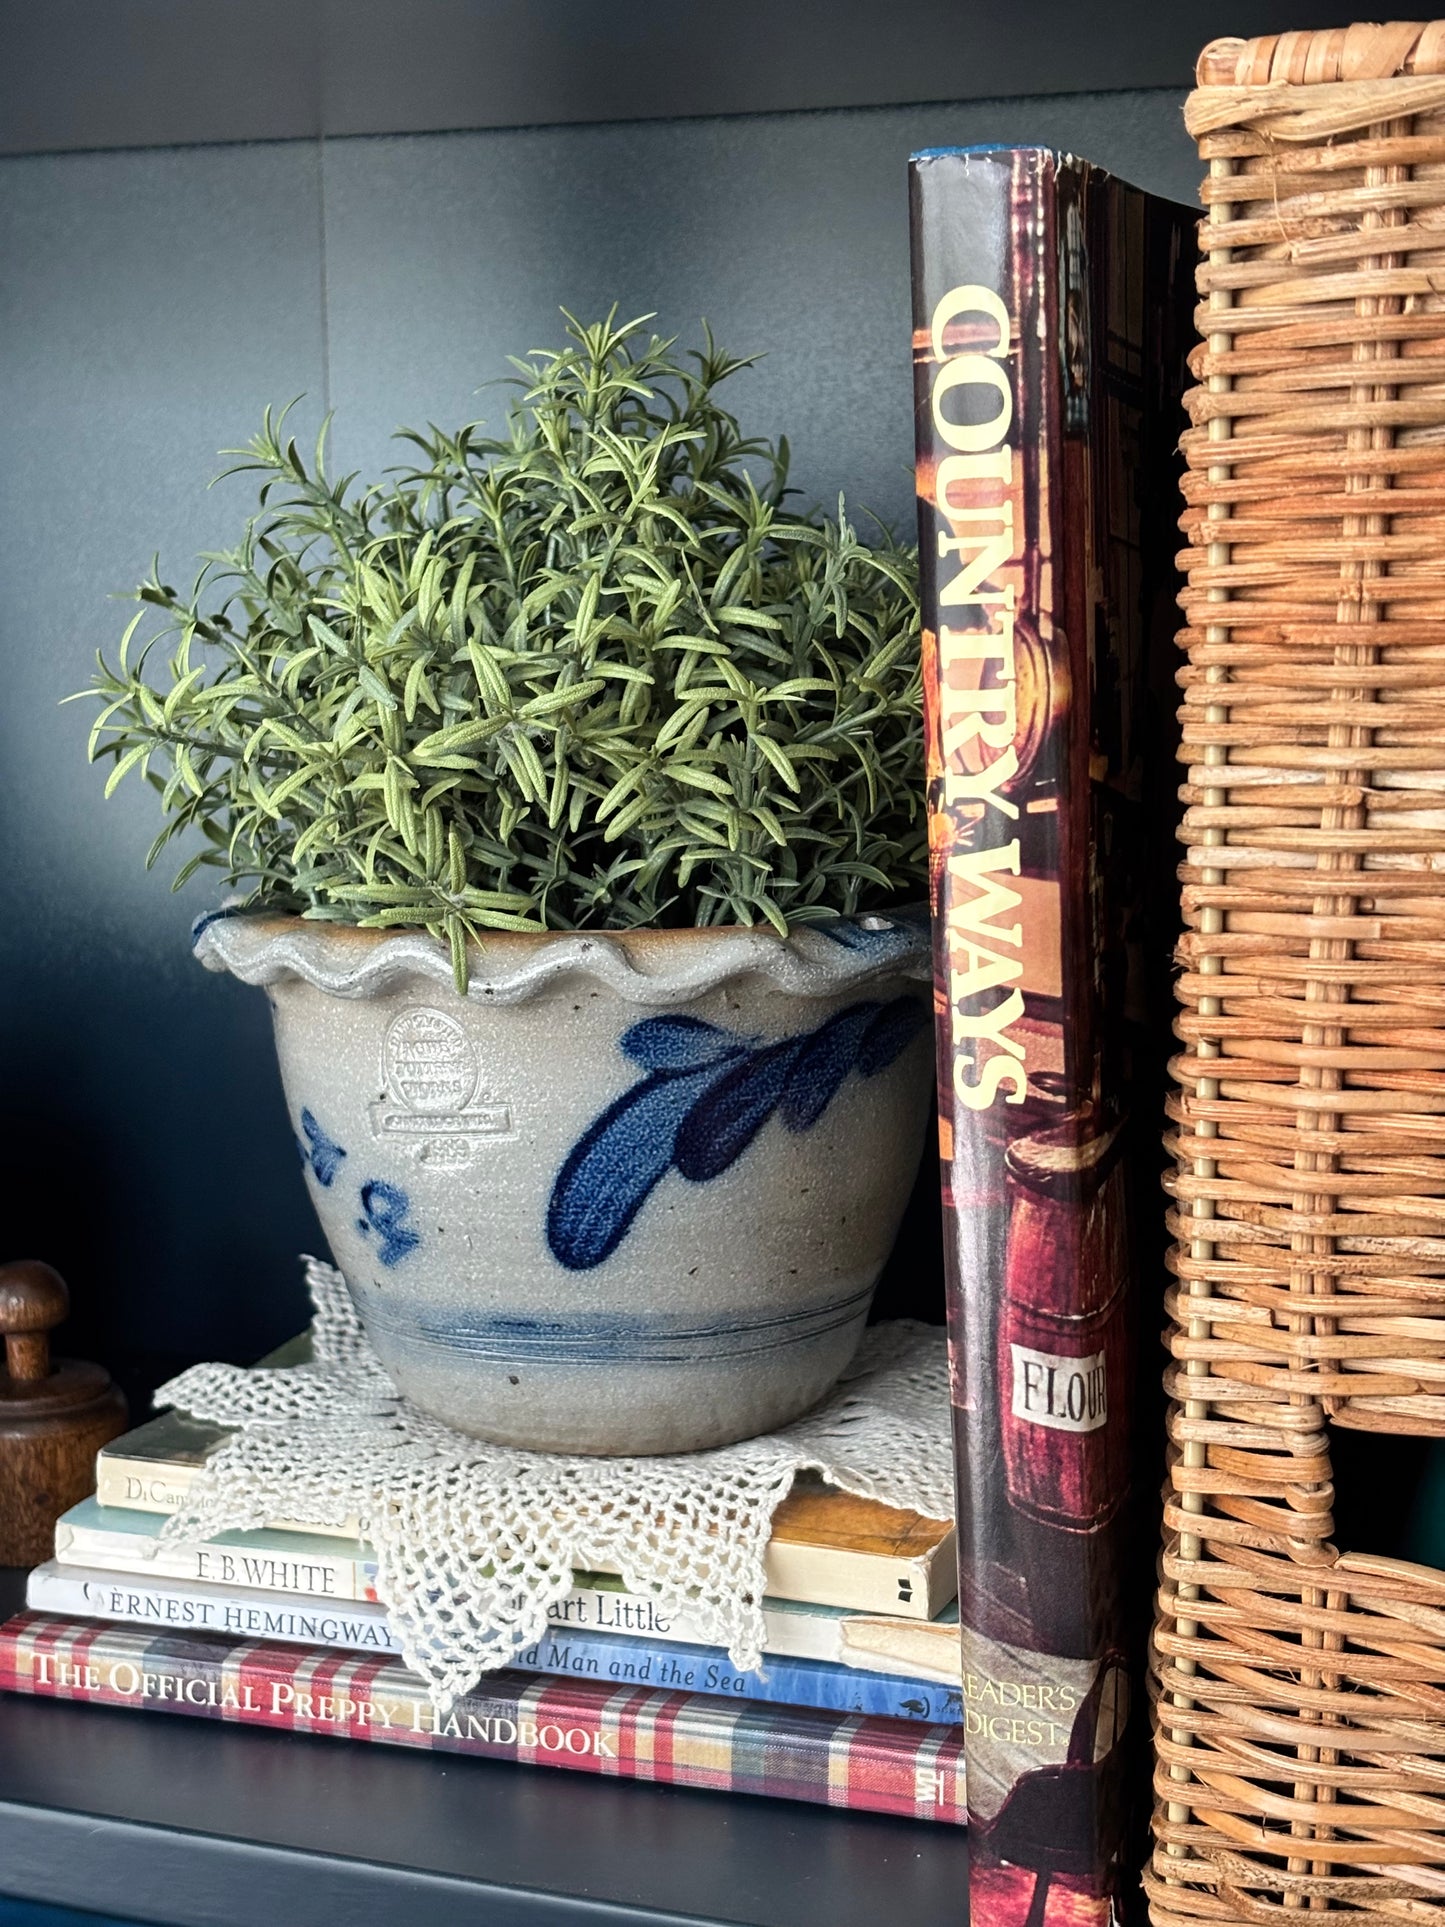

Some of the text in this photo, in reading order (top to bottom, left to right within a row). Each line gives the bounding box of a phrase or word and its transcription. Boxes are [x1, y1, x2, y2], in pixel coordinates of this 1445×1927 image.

[931, 284, 1028, 1111] COUNTRY WAYS
[1022, 1360, 1106, 1422] FLOUR
[241, 1556, 336, 1594] WHITE
[109, 1590, 216, 1625] ERNEST
[223, 1605, 393, 1648] HEMINGWAY
[596, 1594, 671, 1633] Little
[547, 1644, 599, 1673] Man
[608, 1656, 651, 1680] and
[660, 1659, 695, 1686] the
[704, 1673, 746, 1694] Sea
[30, 1650, 617, 1760] THE OFFICIAL PREPPY HANDBOOK
